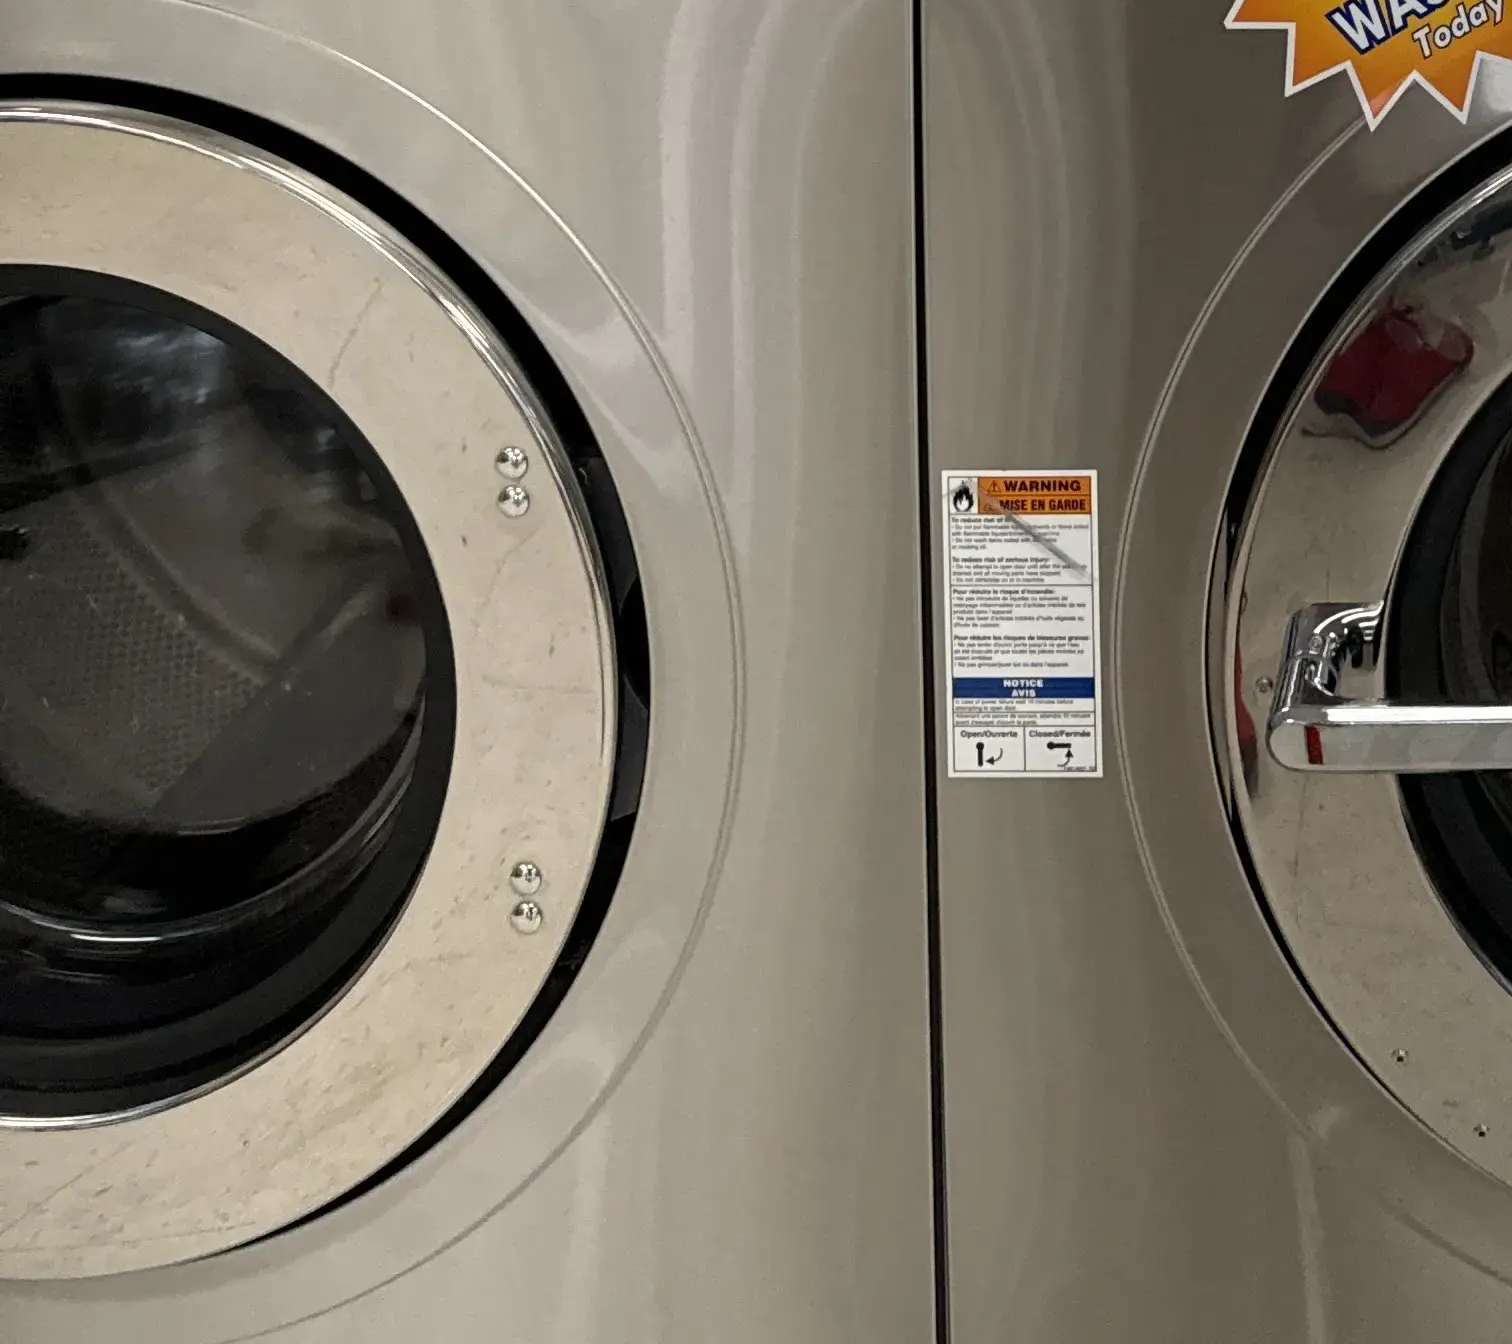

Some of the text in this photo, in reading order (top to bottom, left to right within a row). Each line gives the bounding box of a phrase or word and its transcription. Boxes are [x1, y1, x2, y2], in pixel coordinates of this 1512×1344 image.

[1003, 480, 1081, 492] WARNING
[1000, 499, 1086, 511] MISE EN GARDE
[1003, 679, 1044, 688] NOTICE
[1011, 689, 1036, 698] AVIS
